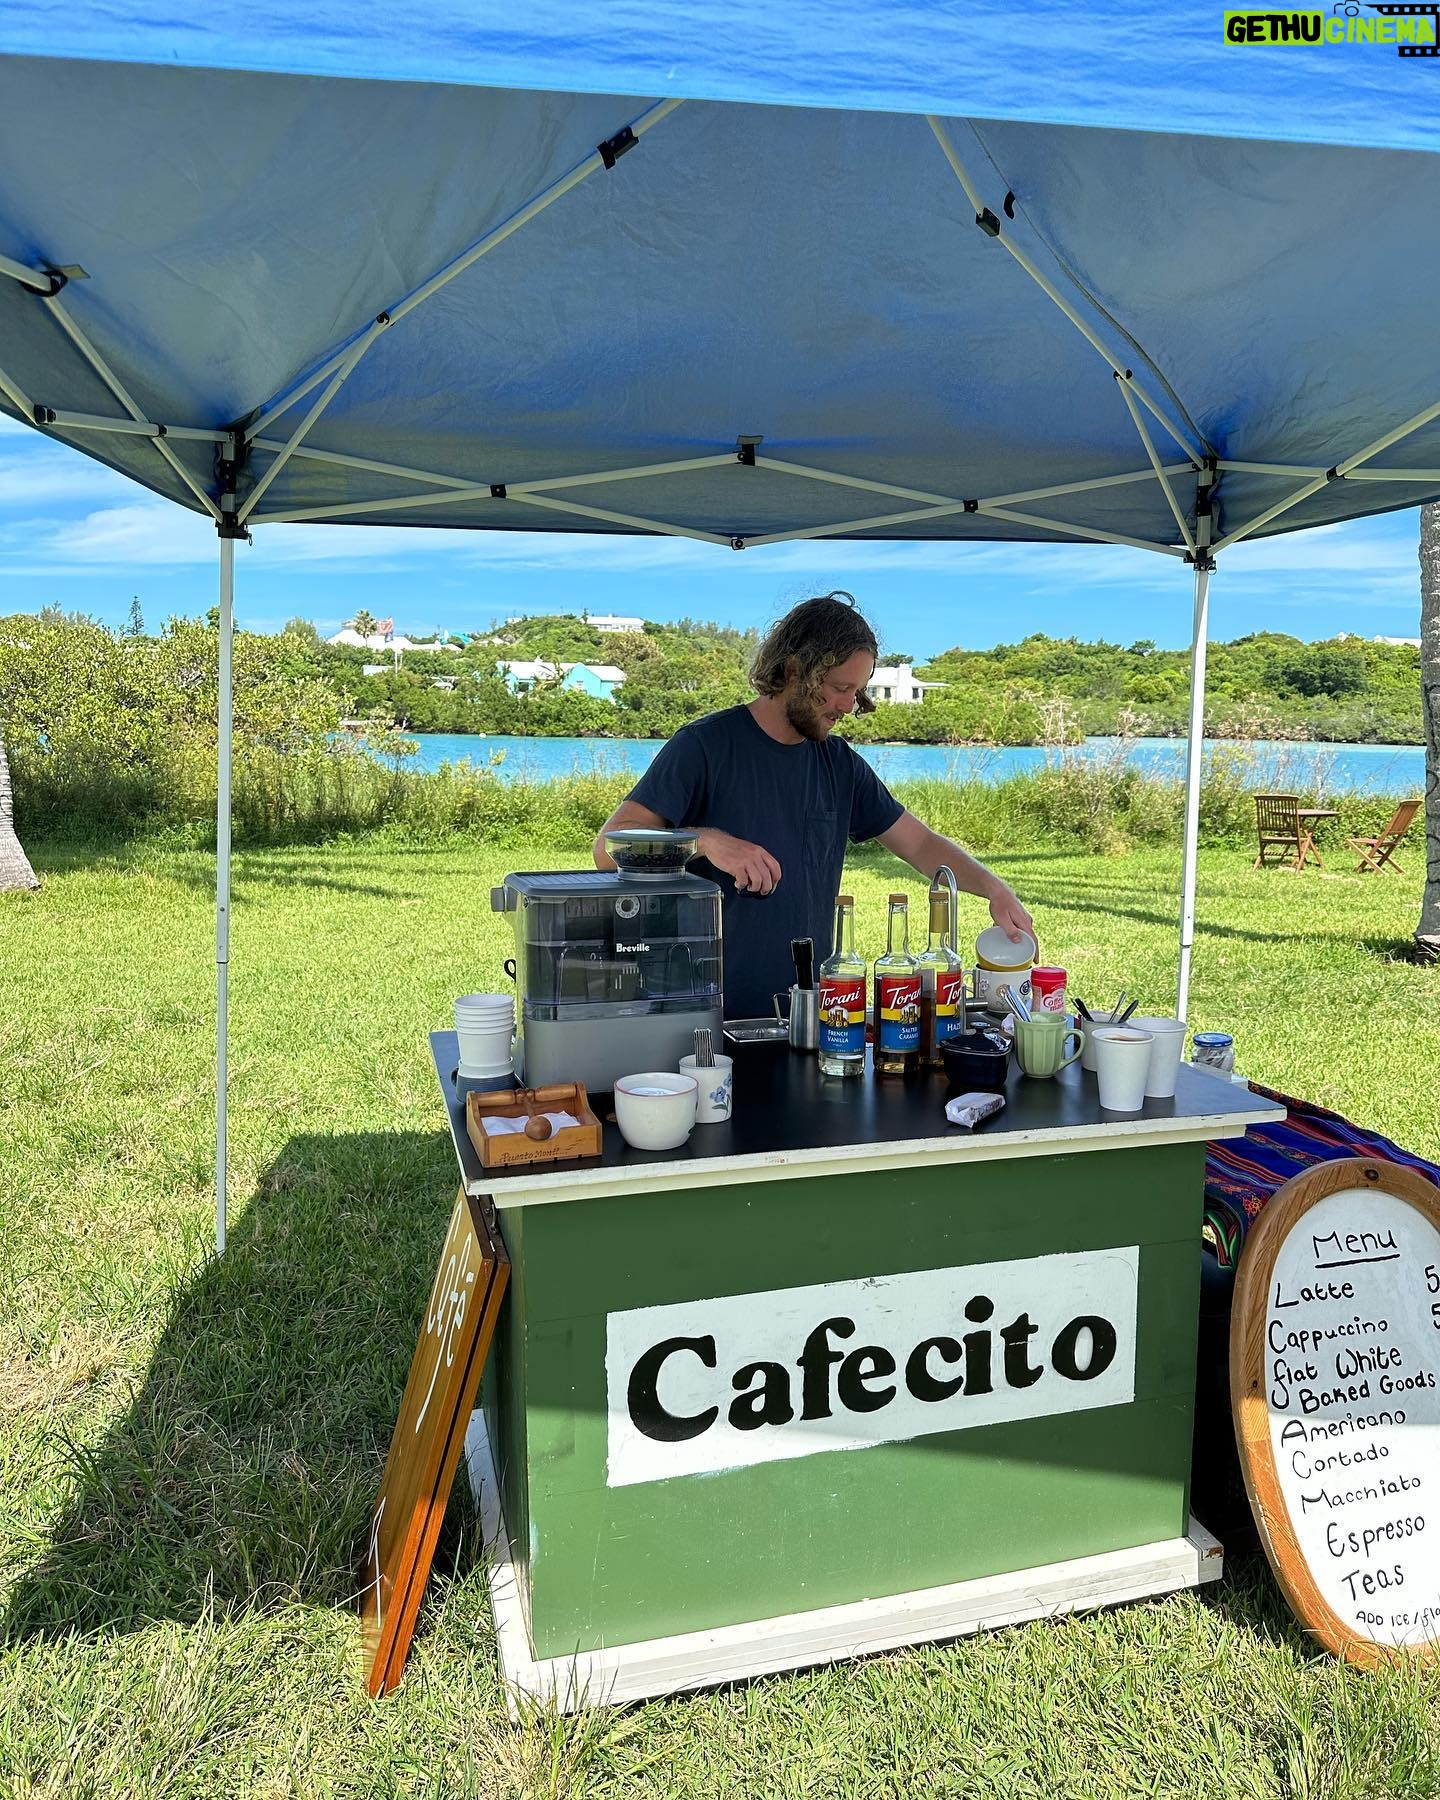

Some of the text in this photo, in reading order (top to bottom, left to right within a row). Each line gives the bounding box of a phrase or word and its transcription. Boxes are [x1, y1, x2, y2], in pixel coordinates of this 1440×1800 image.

[616, 943, 650, 953] Breville
[820, 986, 861, 1010] Torani
[1313, 1229, 1397, 1259] Menu
[1275, 1282, 1355, 1308] Latte
[1268, 1316, 1388, 1354] Cappuccino
[627, 1295, 1117, 1442] Cafecito
[1335, 1346, 1402, 1379] White
[1299, 1370, 1436, 1414] Baked Goods
[1281, 1410, 1406, 1447] Americano
[1292, 1443, 1389, 1479] Cortado
[1301, 1475, 1421, 1514] Macchiato
[1327, 1516, 1425, 1557] Espresso
[1341, 1564, 1404, 1601] Teas
[1356, 1610, 1384, 1626] ADD
